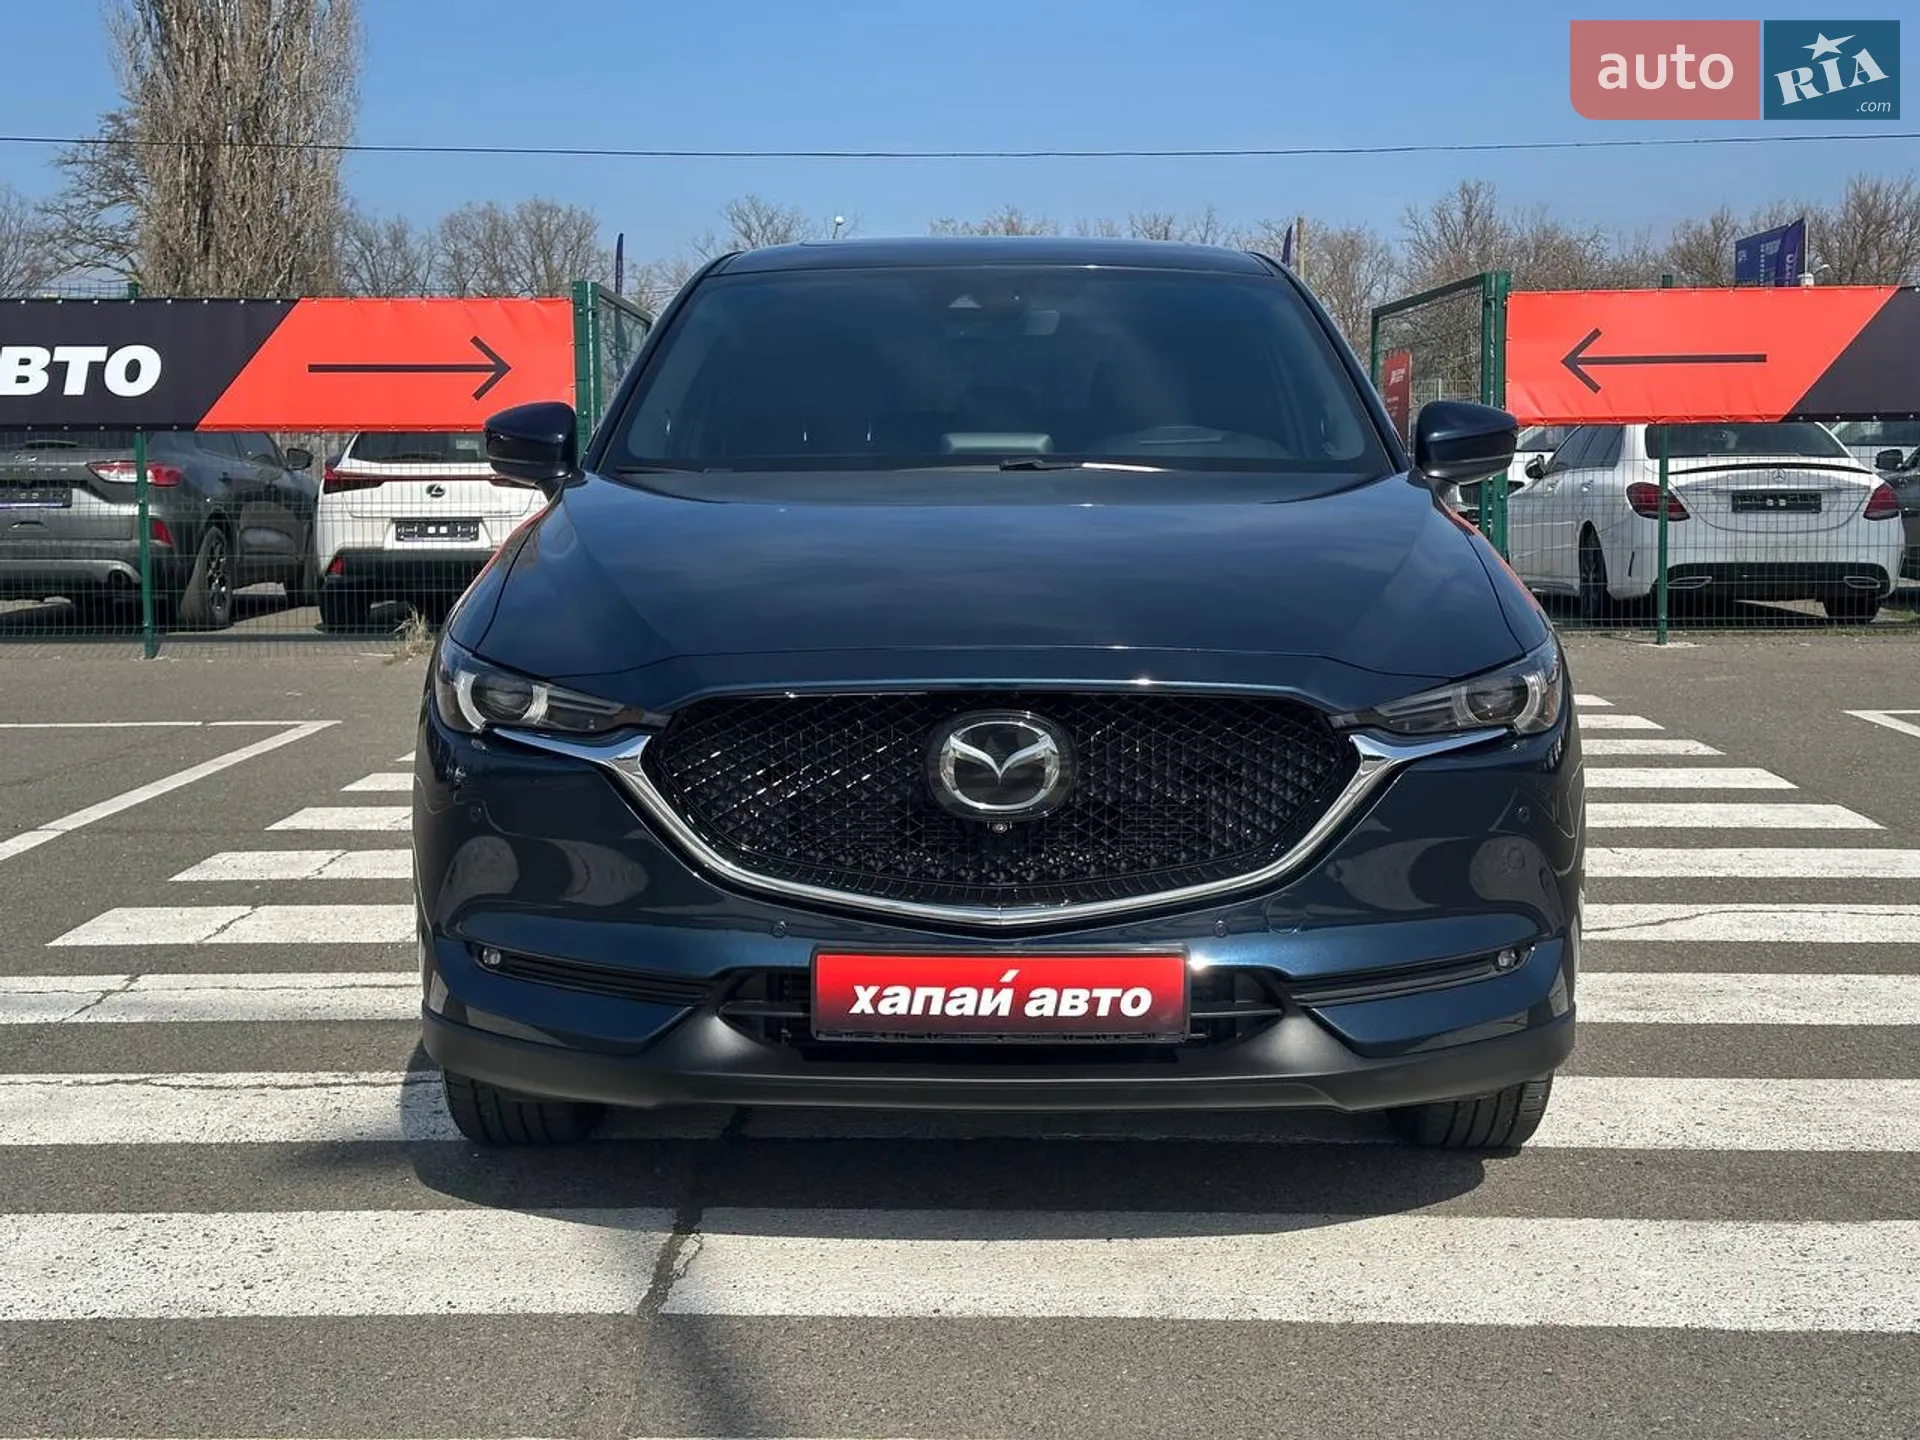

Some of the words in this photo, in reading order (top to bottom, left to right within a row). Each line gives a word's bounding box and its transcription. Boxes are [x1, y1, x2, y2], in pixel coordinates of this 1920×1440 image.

[0, 345, 162, 397] ВТО
[849, 969, 1020, 1017] хапай
[1024, 986, 1152, 1017] авто
